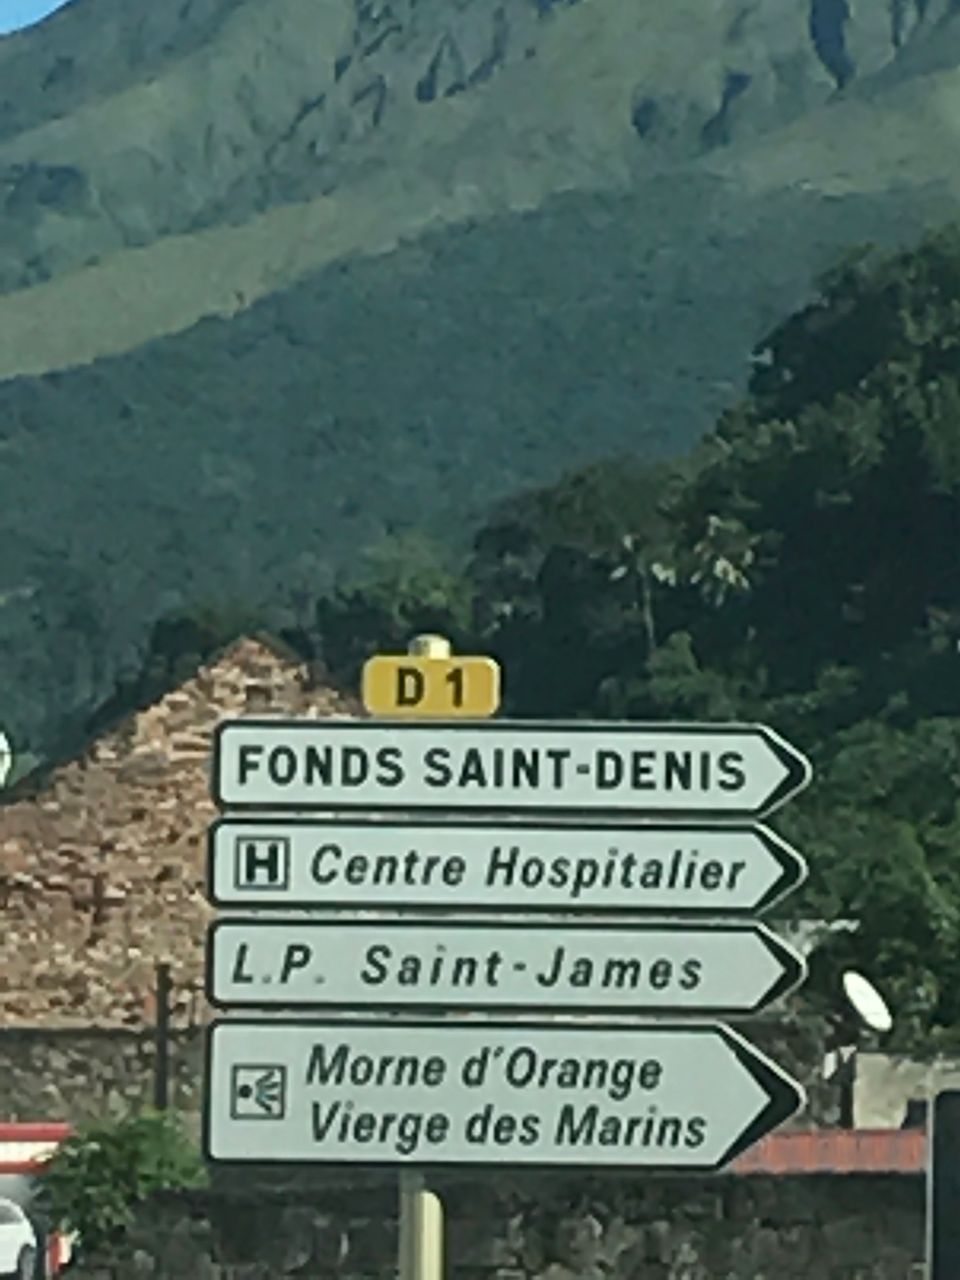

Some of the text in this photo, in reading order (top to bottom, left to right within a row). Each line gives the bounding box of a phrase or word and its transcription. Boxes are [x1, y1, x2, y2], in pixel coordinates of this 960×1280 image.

[396, 669, 464, 706] D 1
[238, 746, 746, 789] FONDS SAINT-DENIS
[245, 844, 279, 881] H
[312, 845, 746, 897] Centre Hospitalier
[233, 945, 701, 988] L.P. Saint-James
[306, 1045, 662, 1098] Morne d'Orange
[311, 1102, 706, 1152] Vierge des Marins
